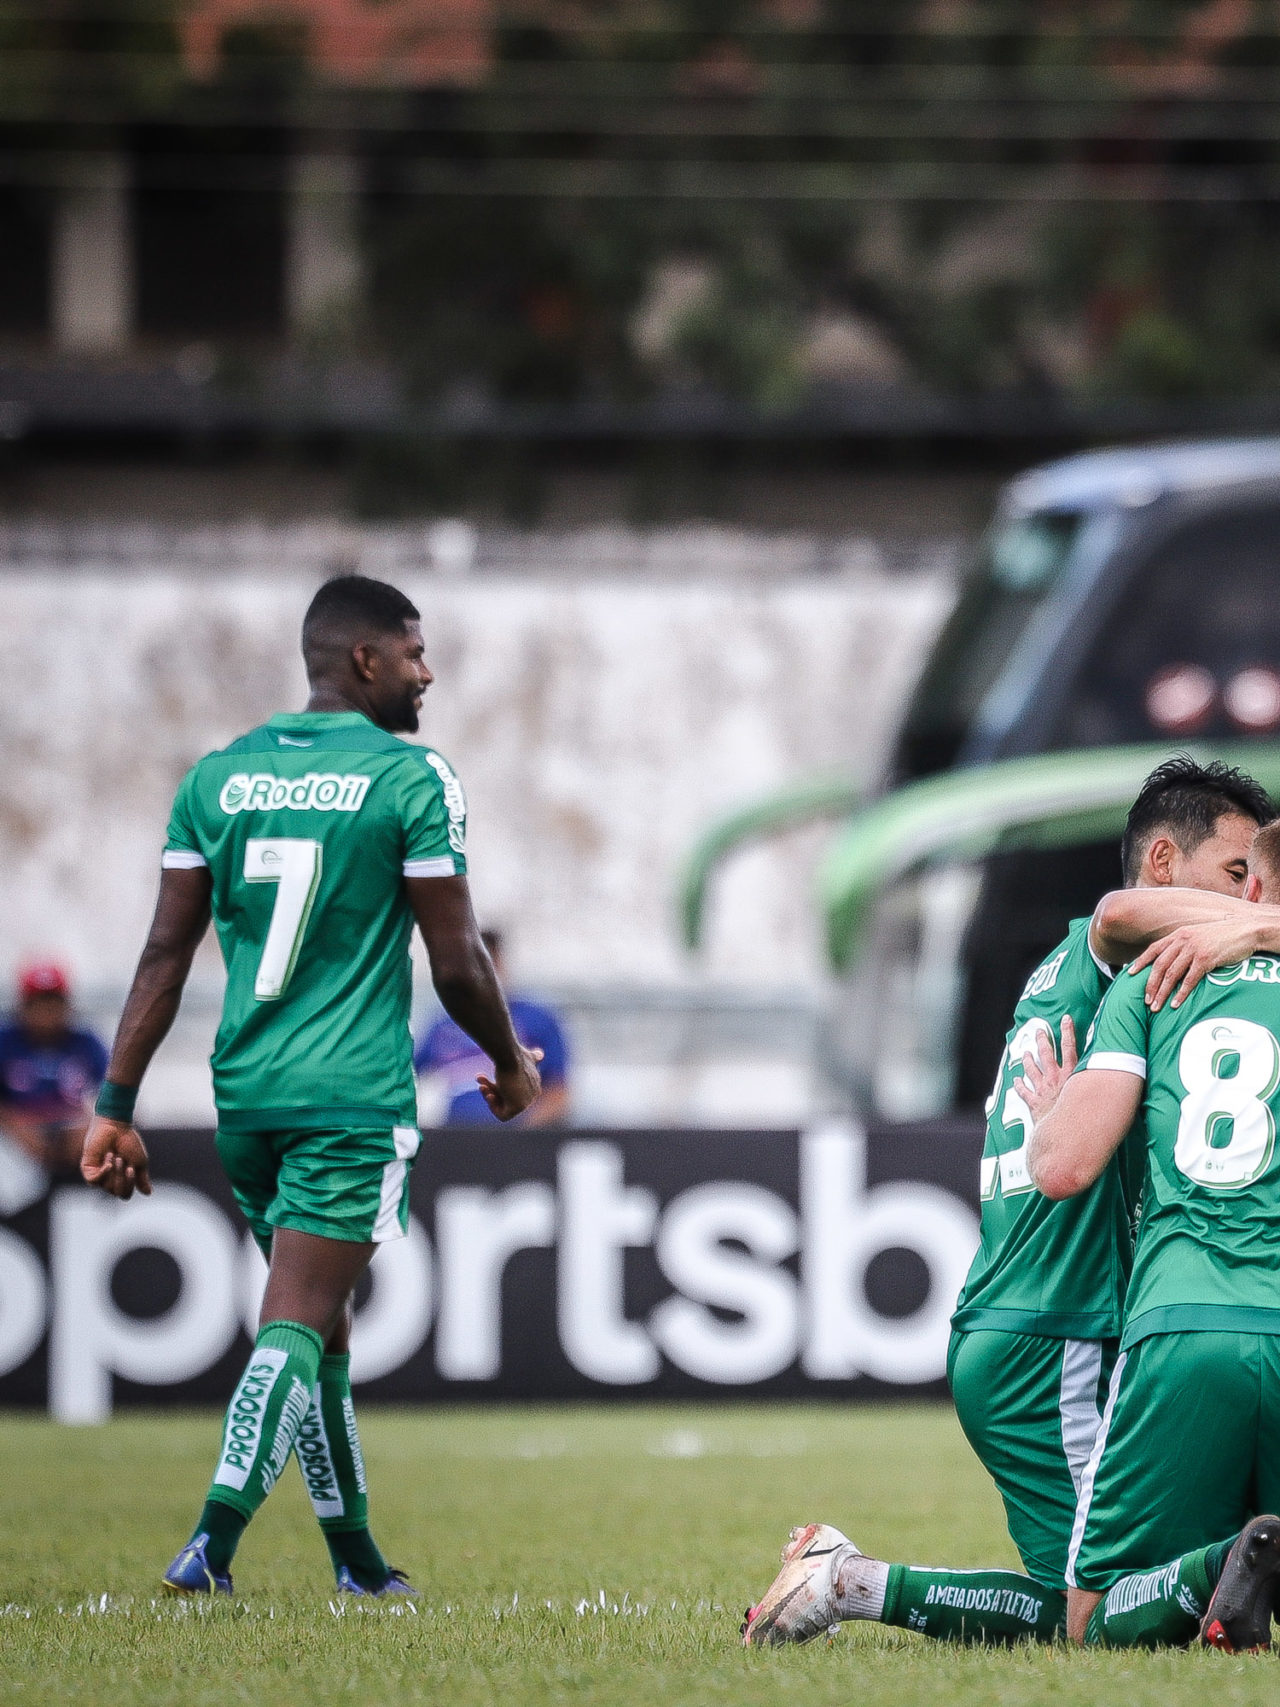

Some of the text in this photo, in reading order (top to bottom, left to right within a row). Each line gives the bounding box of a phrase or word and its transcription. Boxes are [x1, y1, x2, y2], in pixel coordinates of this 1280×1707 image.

[246, 772, 372, 812] RodOil
[245, 837, 323, 1001] 7
[0, 1125, 950, 1420] portsb
[225, 1364, 274, 1472] PROSOCKS
[299, 1402, 339, 1501] PROSOCK
